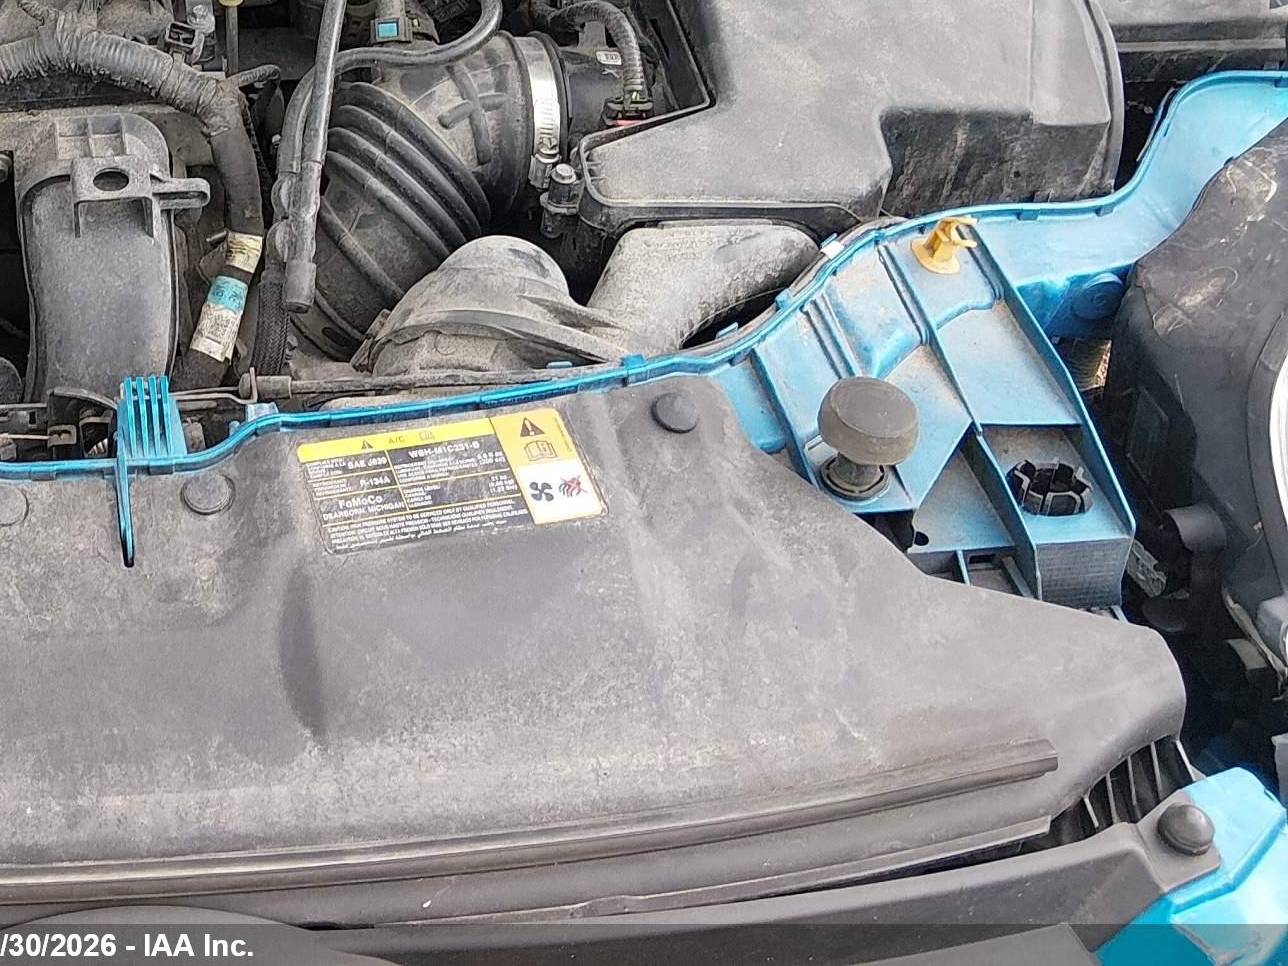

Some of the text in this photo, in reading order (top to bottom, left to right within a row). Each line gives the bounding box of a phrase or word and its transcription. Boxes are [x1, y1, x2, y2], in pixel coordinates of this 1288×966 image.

[388, 436, 406, 444] A/C
[347, 459, 367, 470] SAE
[359, 476, 391, 487] R-134A
[338, 495, 384, 509] FoMoCo
[368, 501, 405, 513] MICHIGAN
